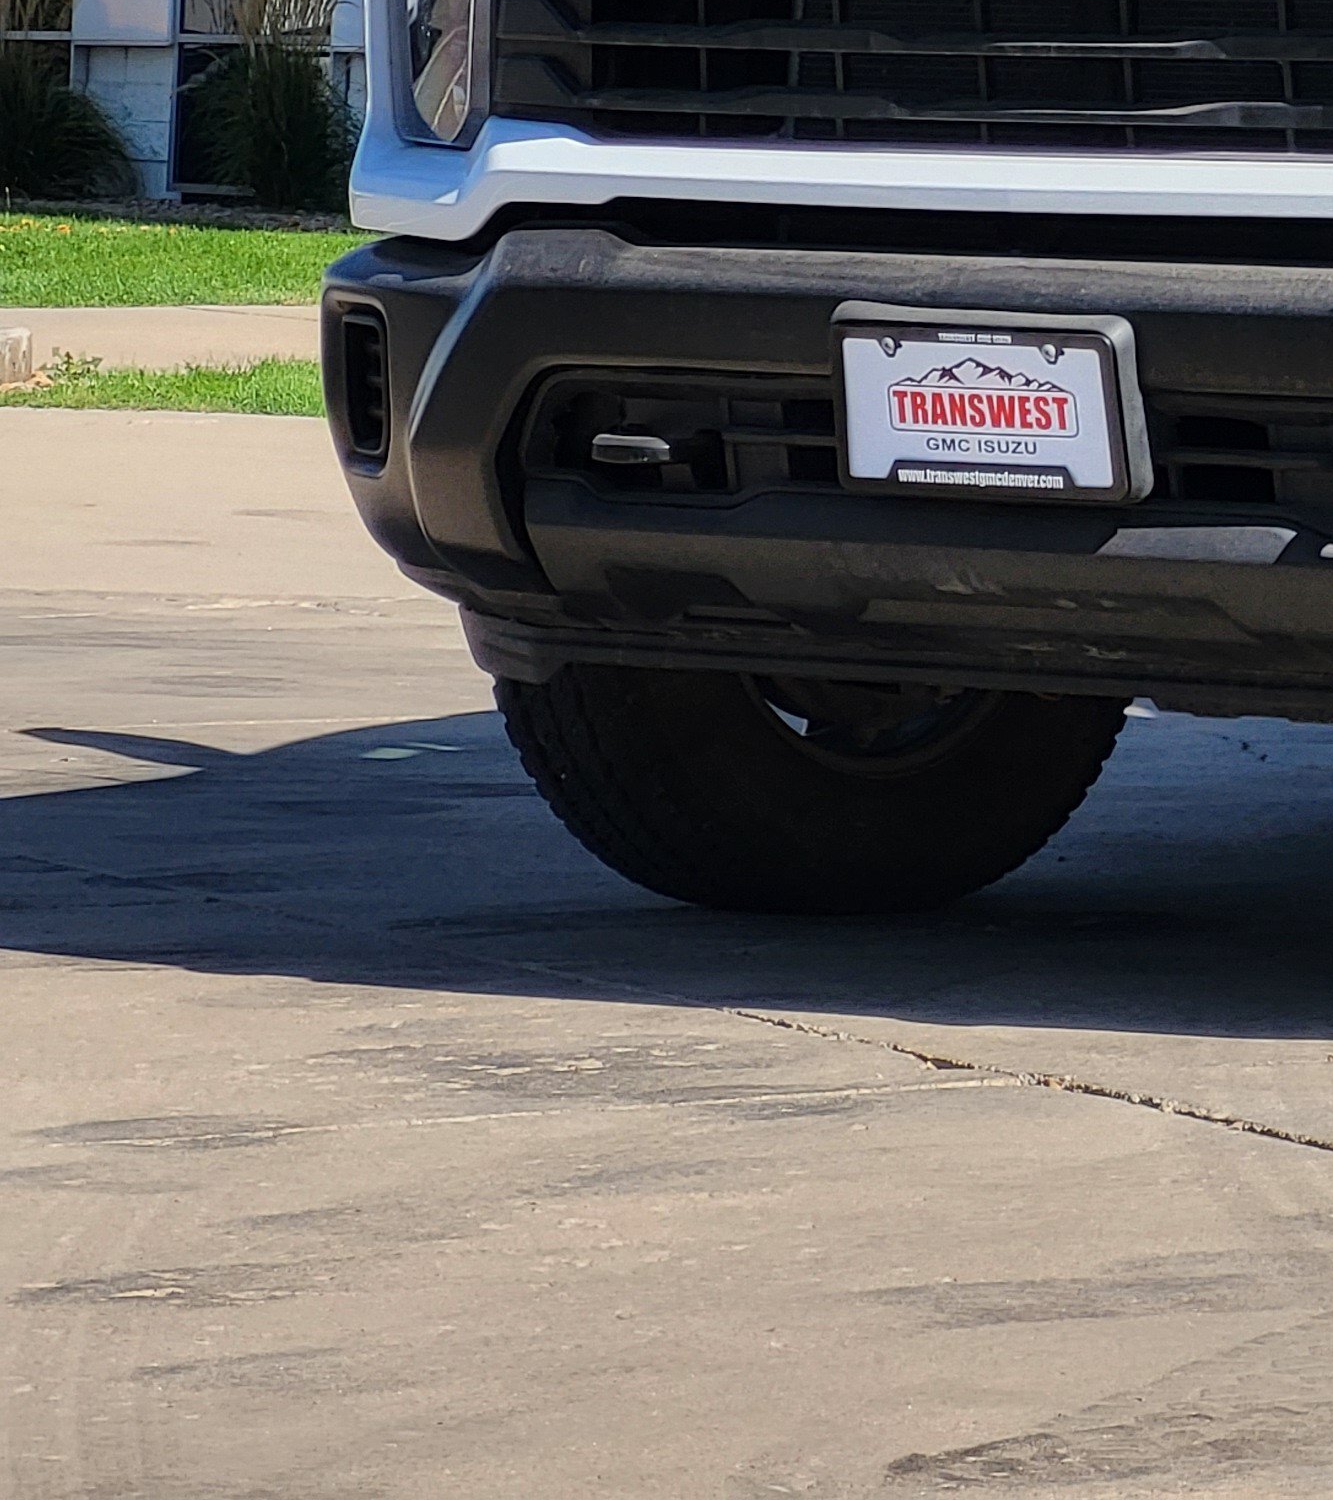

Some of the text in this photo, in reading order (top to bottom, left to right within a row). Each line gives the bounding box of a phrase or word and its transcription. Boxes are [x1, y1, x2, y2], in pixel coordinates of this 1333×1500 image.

[892, 390, 1068, 430] TRANSWEST
[926, 437, 1038, 455] GMC ISUZU
[898, 468, 1064, 489] www.transwestgmcdenver.com
